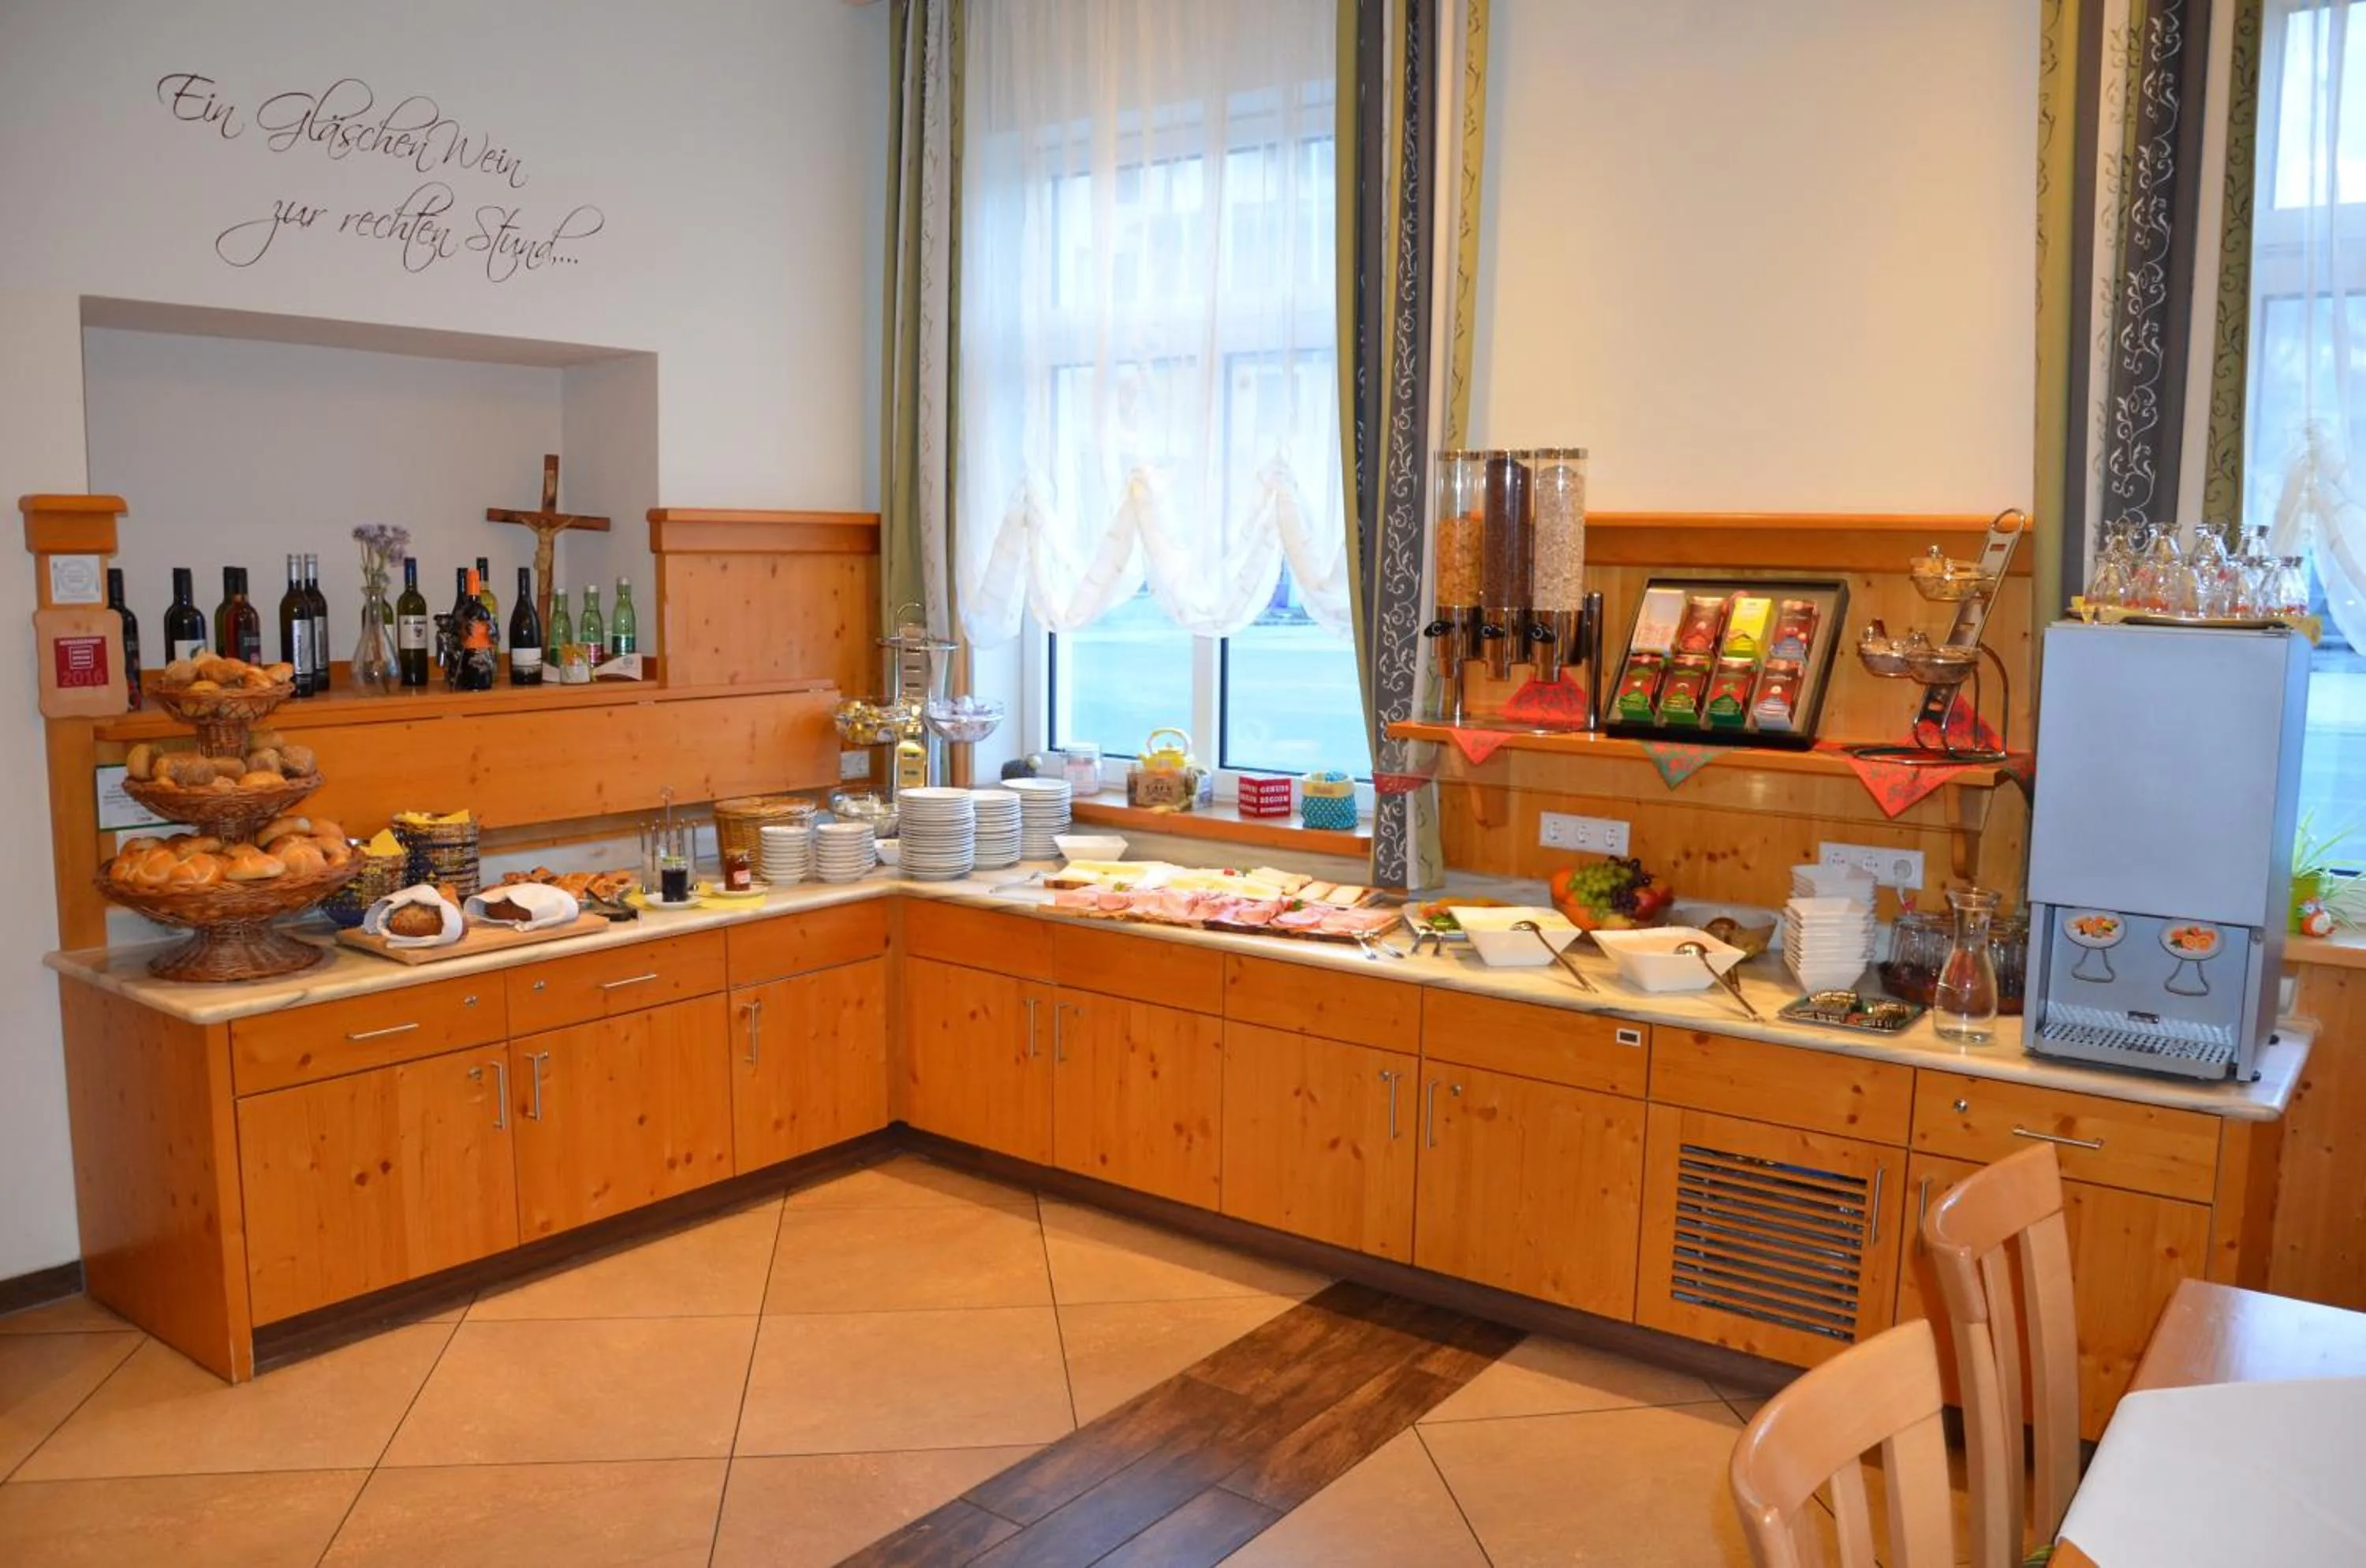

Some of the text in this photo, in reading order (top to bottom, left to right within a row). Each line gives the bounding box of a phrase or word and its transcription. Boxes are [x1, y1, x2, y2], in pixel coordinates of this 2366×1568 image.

[157, 73, 528, 189] Ein Gläschen Wein
[215, 199, 328, 267] zur
[338, 181, 459, 273] rechten
